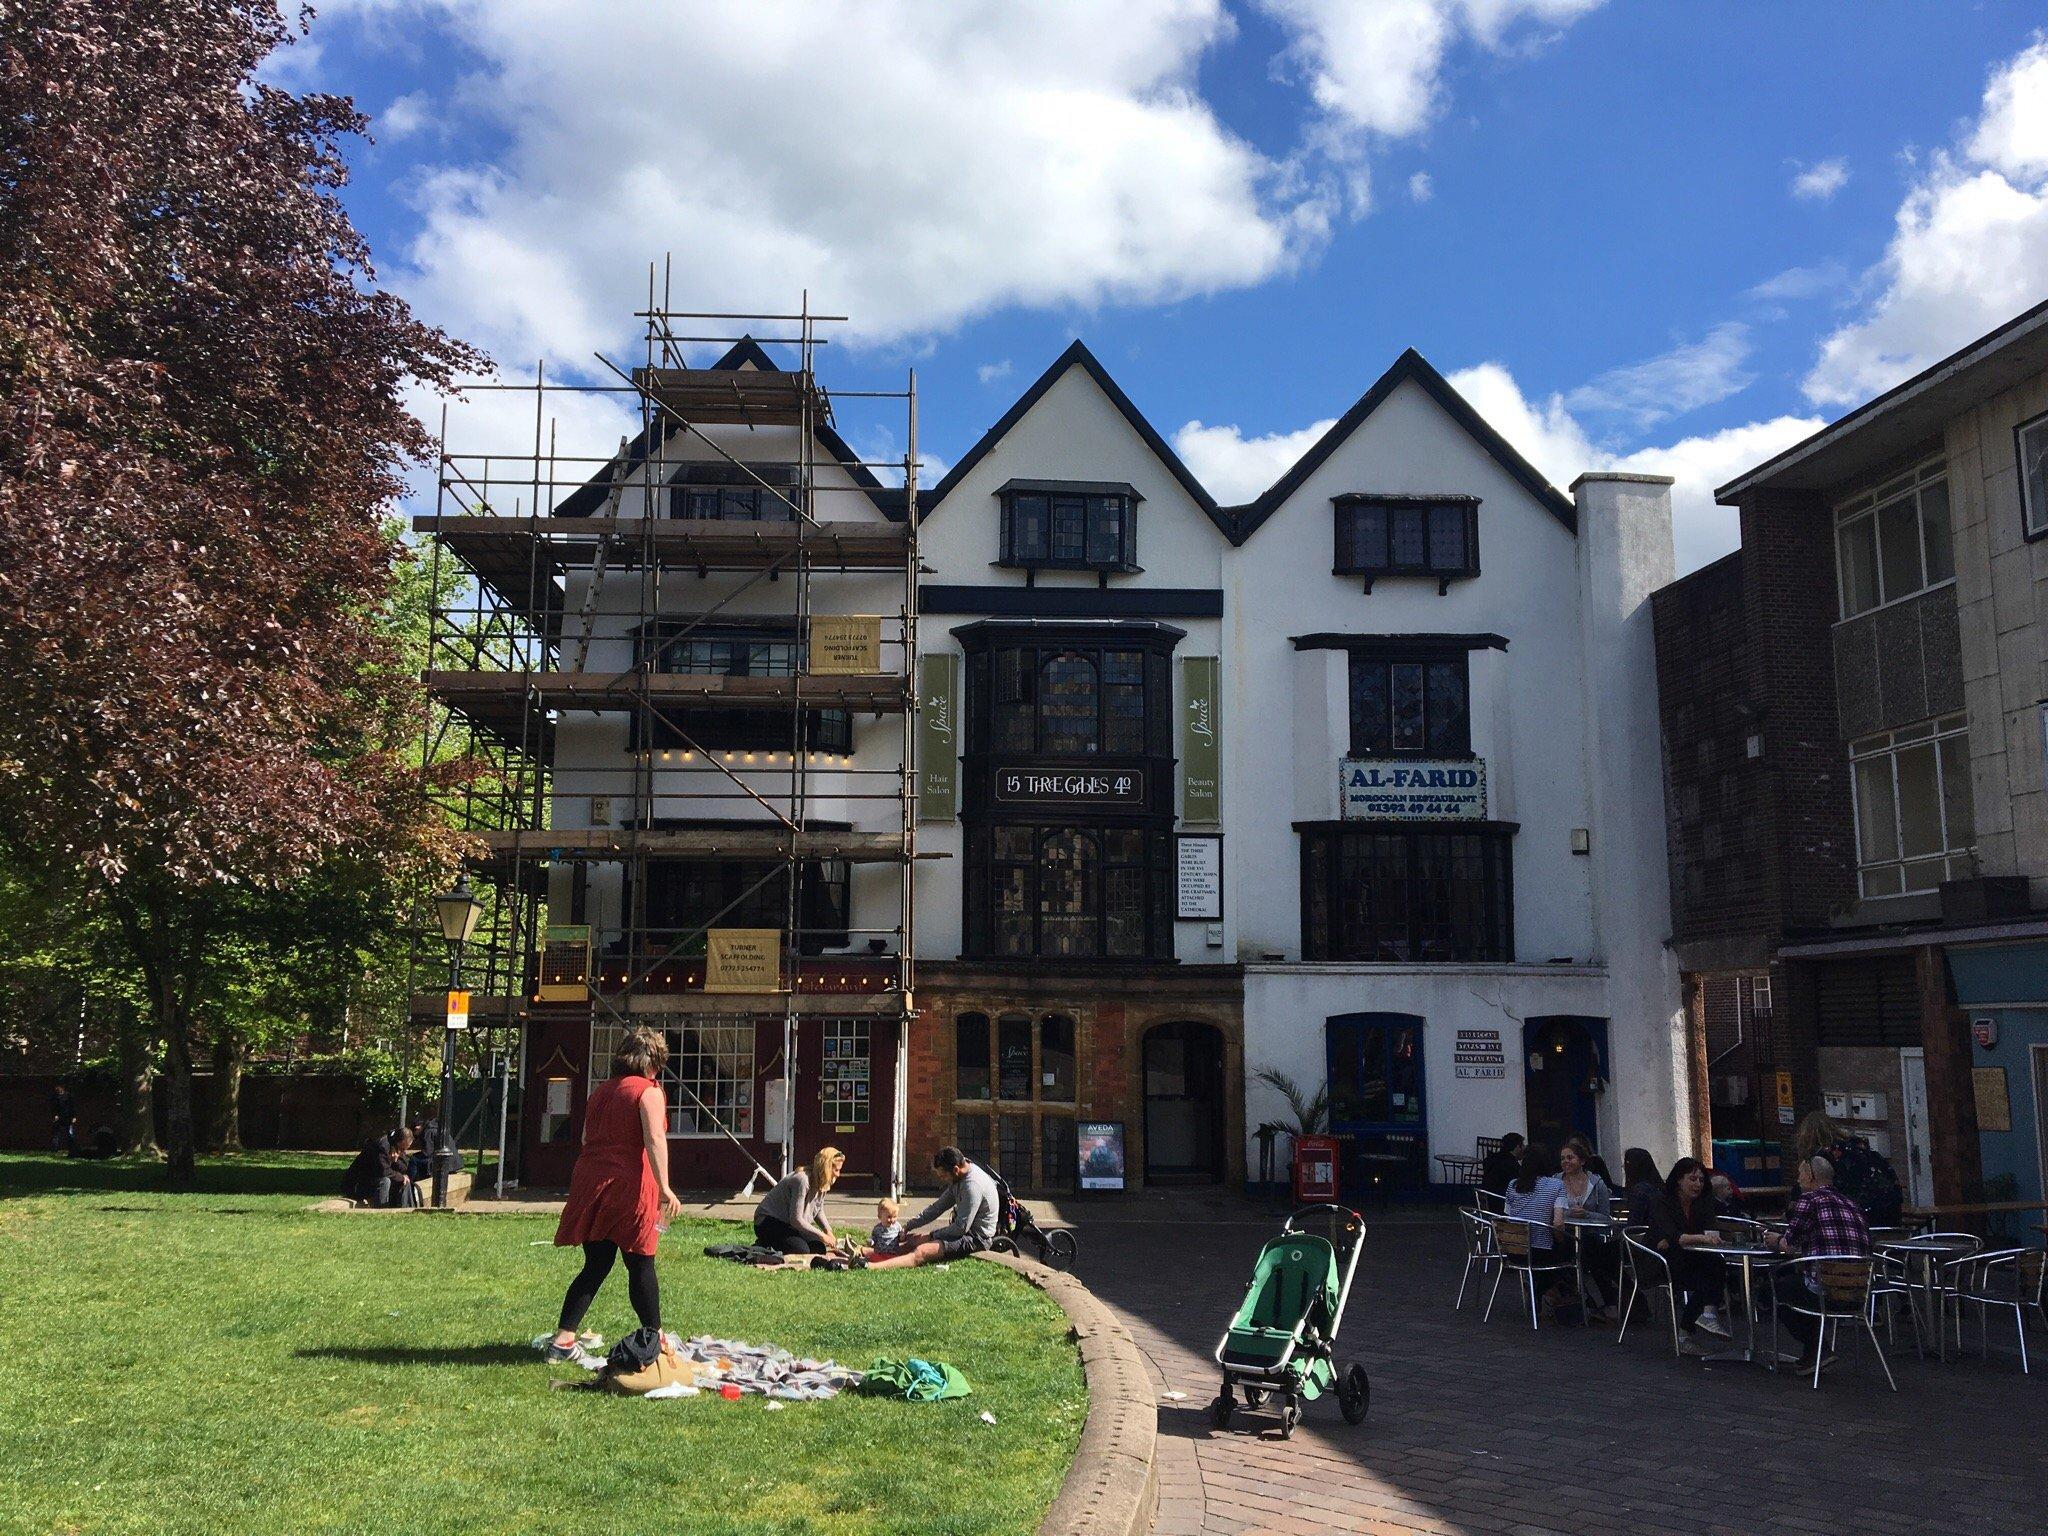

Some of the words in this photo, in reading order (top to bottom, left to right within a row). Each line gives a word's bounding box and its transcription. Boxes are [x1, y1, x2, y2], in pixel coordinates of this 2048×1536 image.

[930, 696, 952, 744] Space
[1190, 699, 1213, 747] Space
[929, 774, 948, 783] Hair
[1188, 777, 1214, 786] Beauty
[1349, 769, 1478, 788] AL-FARID
[1007, 776, 1021, 793] 15
[926, 785, 950, 795] Salon
[1189, 788, 1213, 798] Salon
[1409, 795, 1477, 803] RESTAURANT
[1367, 803, 1406, 813] 01392
[1408, 803, 1425, 813] 49
[1426, 803, 1443, 813] 44
[1444, 803, 1461, 813] 44
